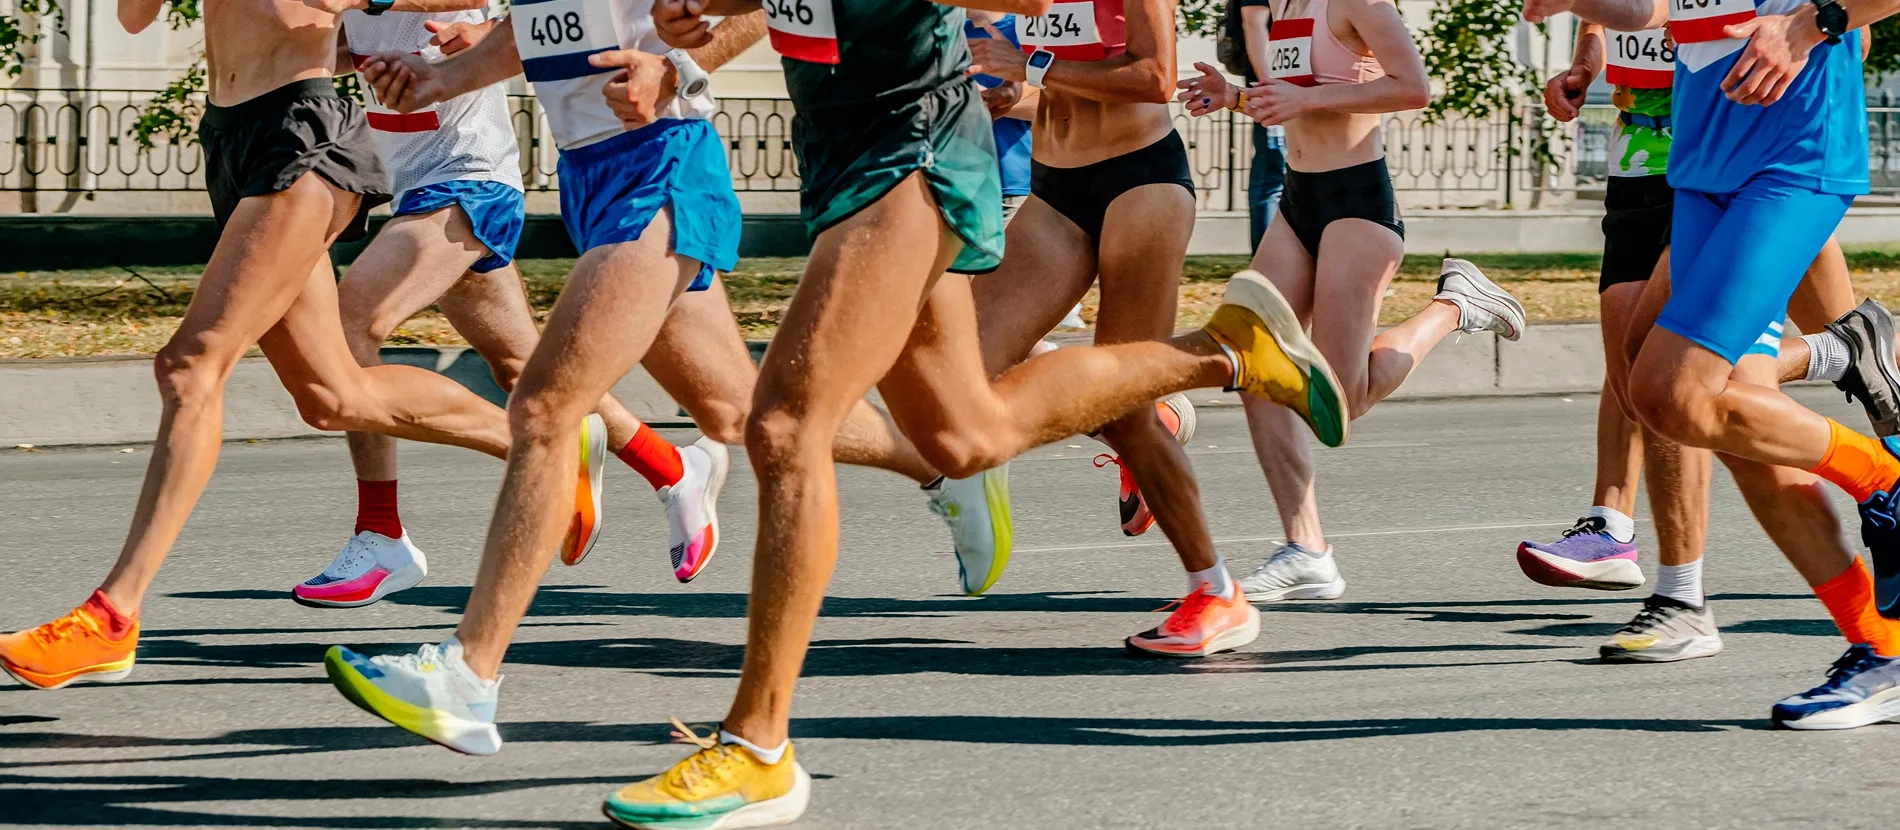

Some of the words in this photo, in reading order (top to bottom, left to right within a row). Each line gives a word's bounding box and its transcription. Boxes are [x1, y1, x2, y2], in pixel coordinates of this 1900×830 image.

[531, 11, 584, 46] 408
[1025, 13, 1081, 38] 2034
[1615, 33, 1676, 63] 1048
